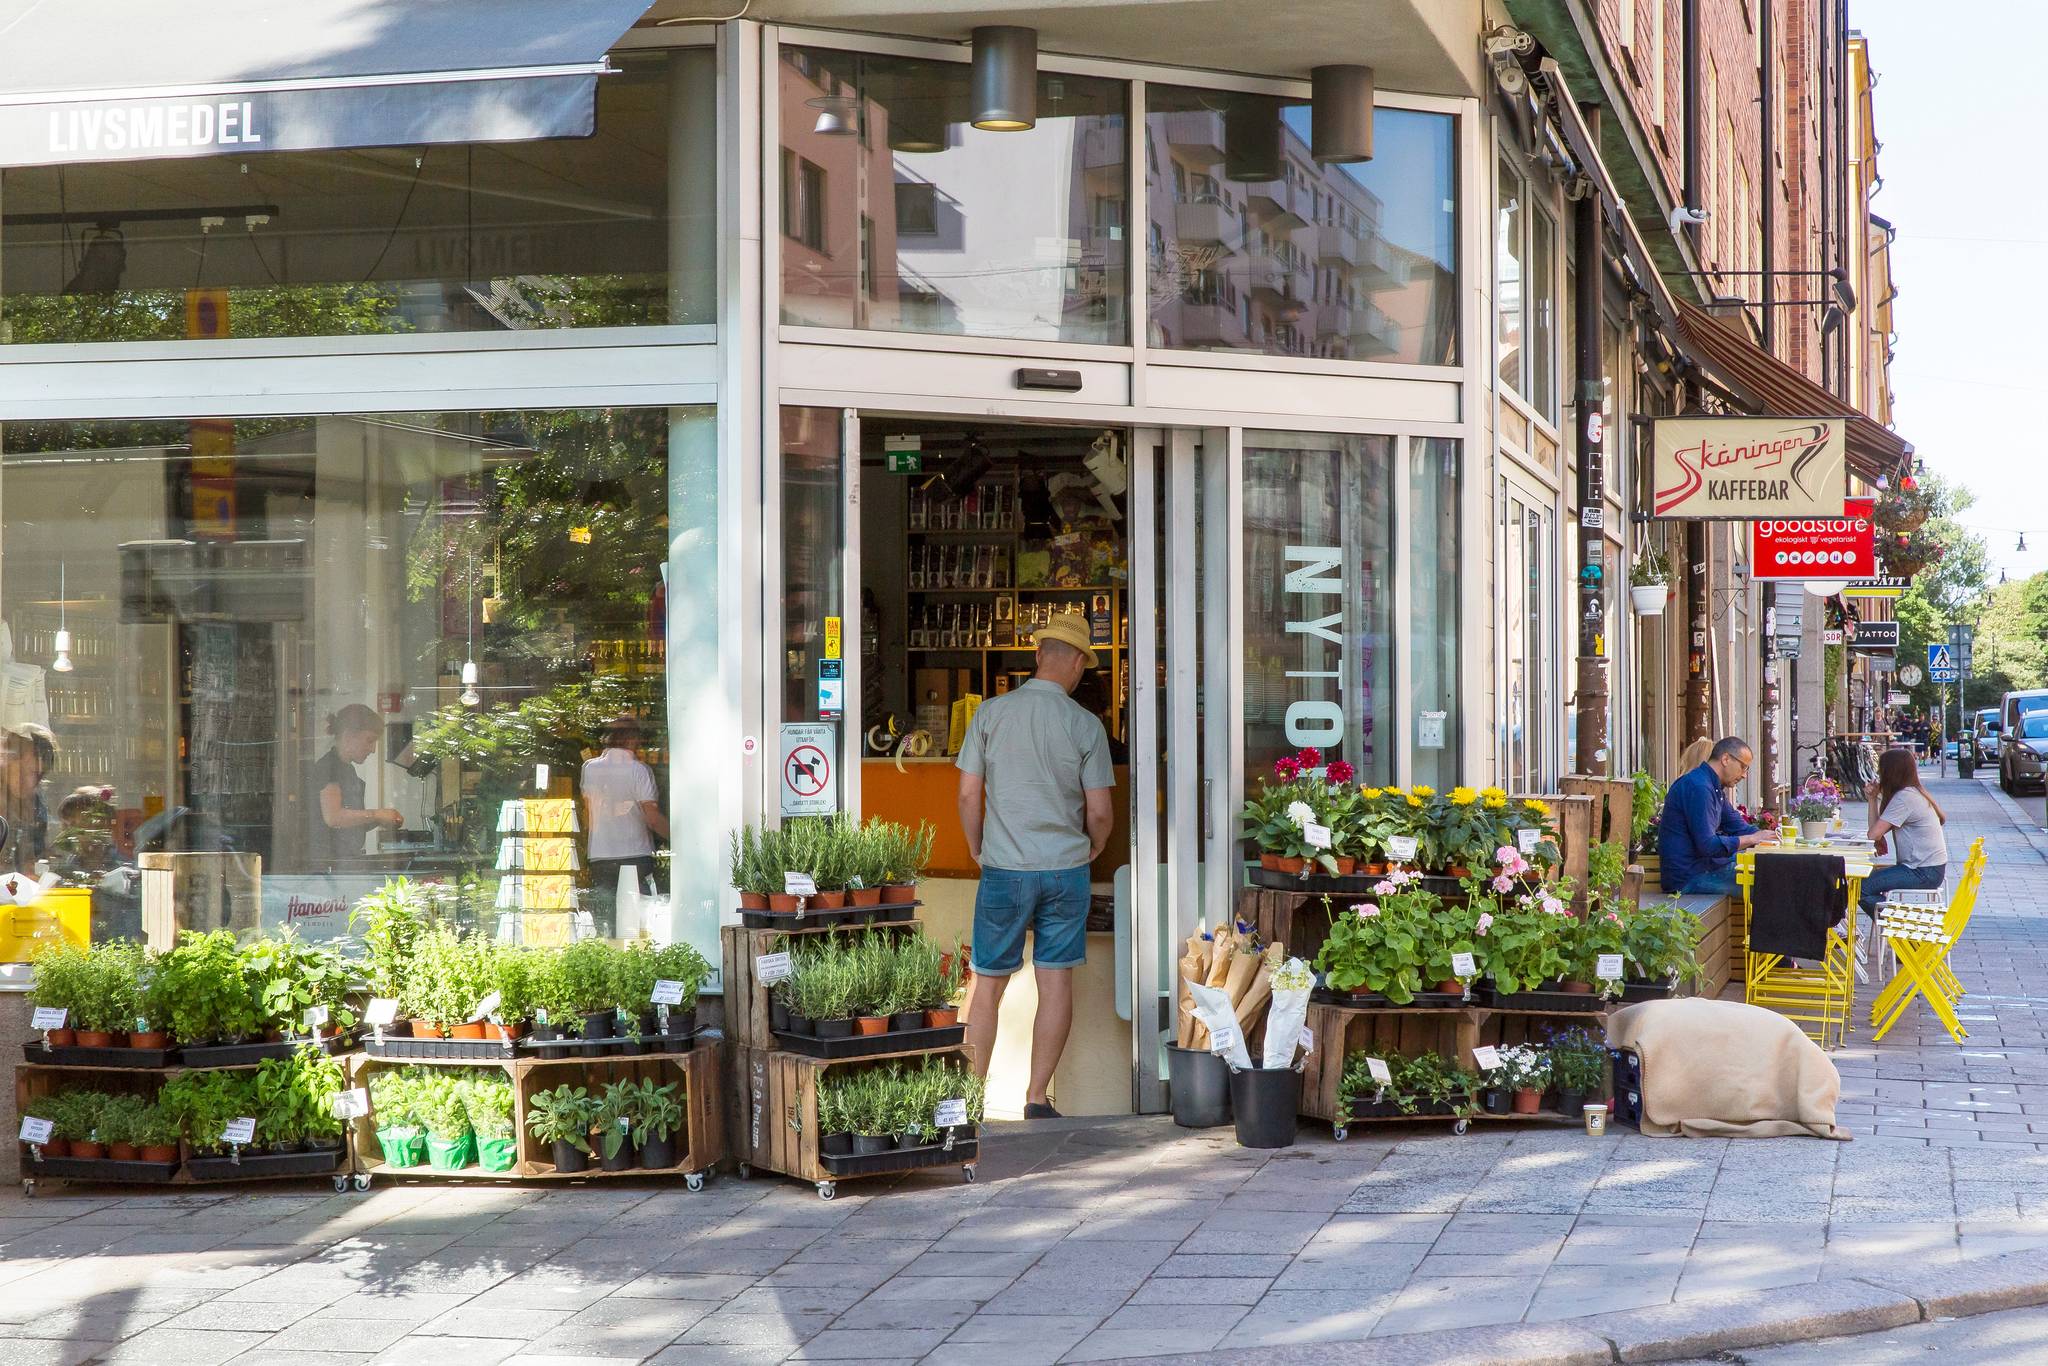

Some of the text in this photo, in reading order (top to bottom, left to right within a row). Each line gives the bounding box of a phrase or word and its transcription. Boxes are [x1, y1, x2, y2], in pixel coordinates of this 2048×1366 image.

[49, 101, 261, 152] LIVSMEDEL
[1708, 480, 1789, 500] KAFFEBAR
[1775, 536, 1856, 544] ekologiskt vegetariskt
[1285, 545, 1343, 780] NYTO
